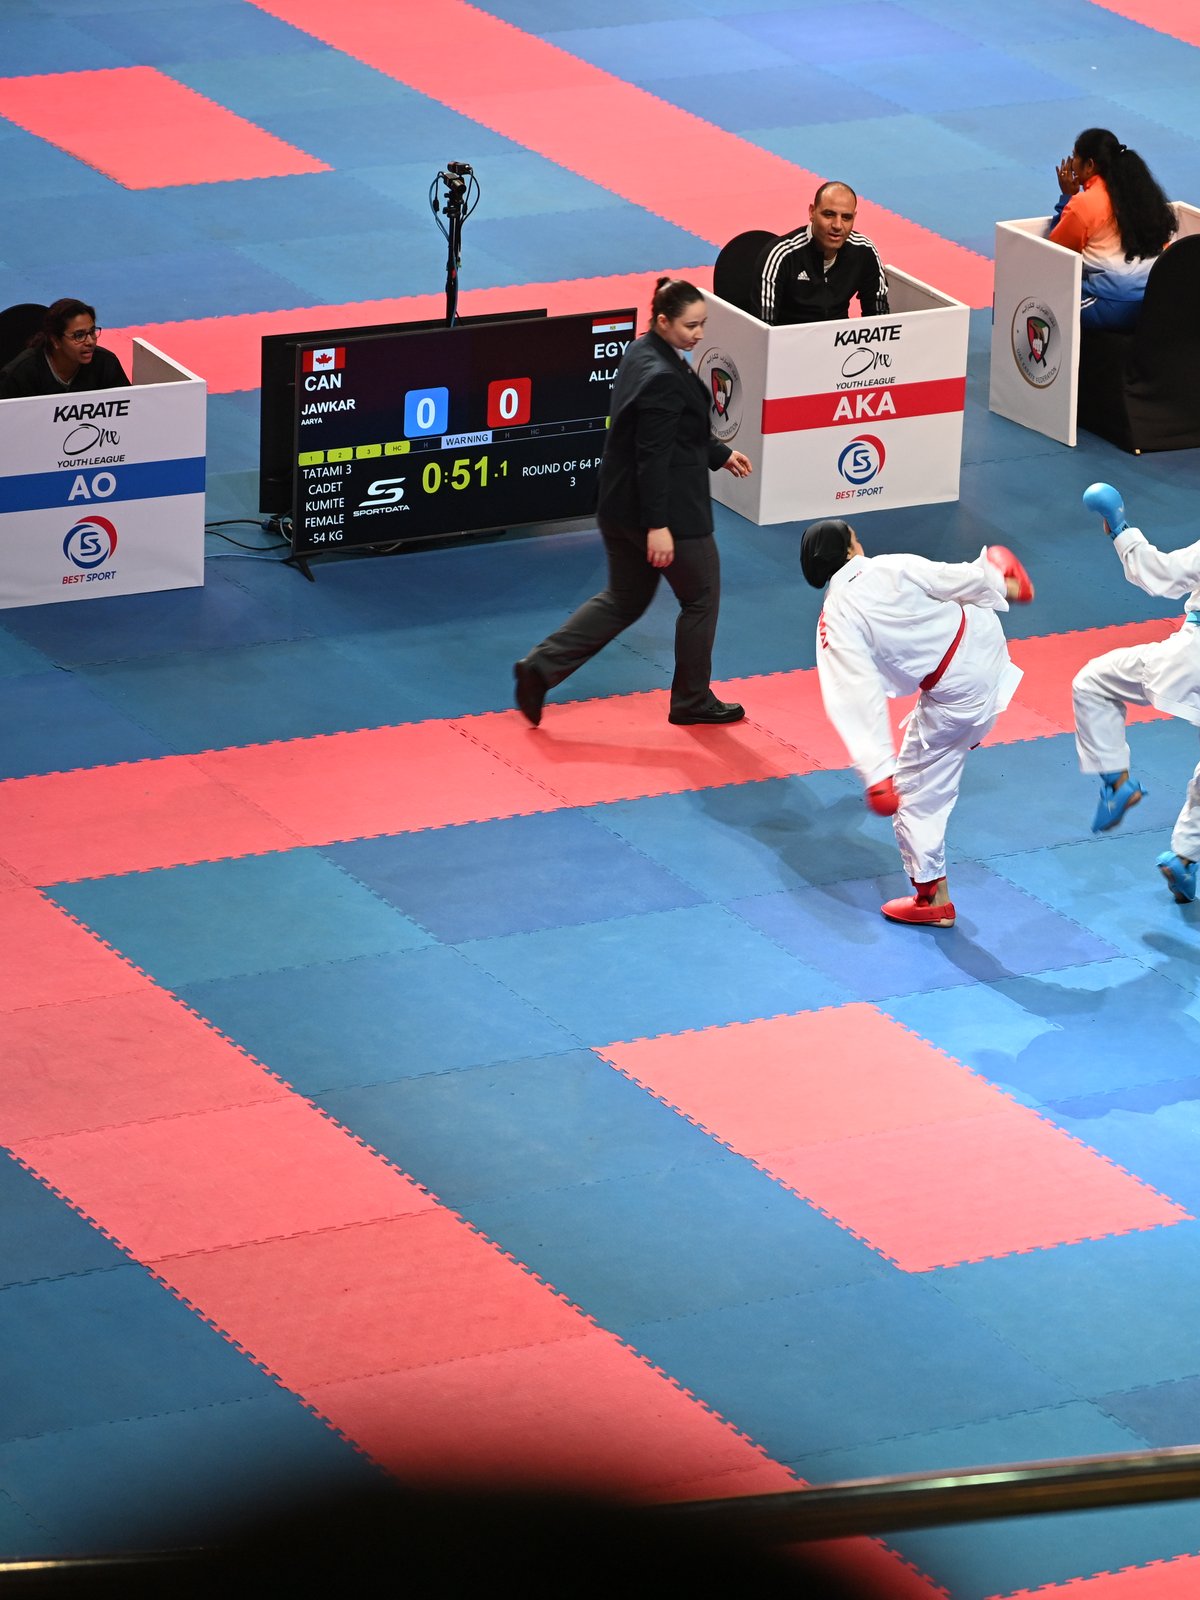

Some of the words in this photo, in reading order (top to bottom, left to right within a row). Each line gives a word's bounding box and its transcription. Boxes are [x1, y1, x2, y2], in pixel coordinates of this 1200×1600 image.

[834, 324, 902, 347] KARATE
[594, 340, 630, 359] EGY
[841, 347, 892, 378] One
[304, 373, 342, 391] CAN
[836, 380, 863, 390] YOUTH
[864, 376, 896, 387] LEAGUE
[53, 399, 131, 423] KARATE
[301, 399, 356, 415] JAWKAR
[500, 387, 519, 420] 0
[832, 390, 897, 421] AKA
[301, 417, 323, 426] AARYA
[416, 397, 436, 430] 0
[62, 423, 120, 456] One
[446, 434, 489, 446] WARNING
[57, 458, 88, 468] YOUTH
[89, 454, 126, 465] LEAGUE
[522, 463, 560, 477] ROUND
[563, 460, 577, 472] OF
[579, 458, 592, 470] 64
[303, 465, 342, 480] TATAMI
[346, 464, 352, 475] 3
[68, 472, 117, 501] AO
[308, 482, 343, 495] CADET
[570, 476, 576, 487] 3
[836, 490, 856, 500] BEST
[856, 486, 884, 498] SPORT
[305, 497, 345, 512] KUMITE
[352, 504, 410, 517] SPORTDATA
[305, 514, 344, 528] FEMALE
[309, 532, 326, 544] -54
[328, 530, 343, 542] KG
[62, 574, 86, 584] BEST
[86, 570, 117, 582] SPORT
